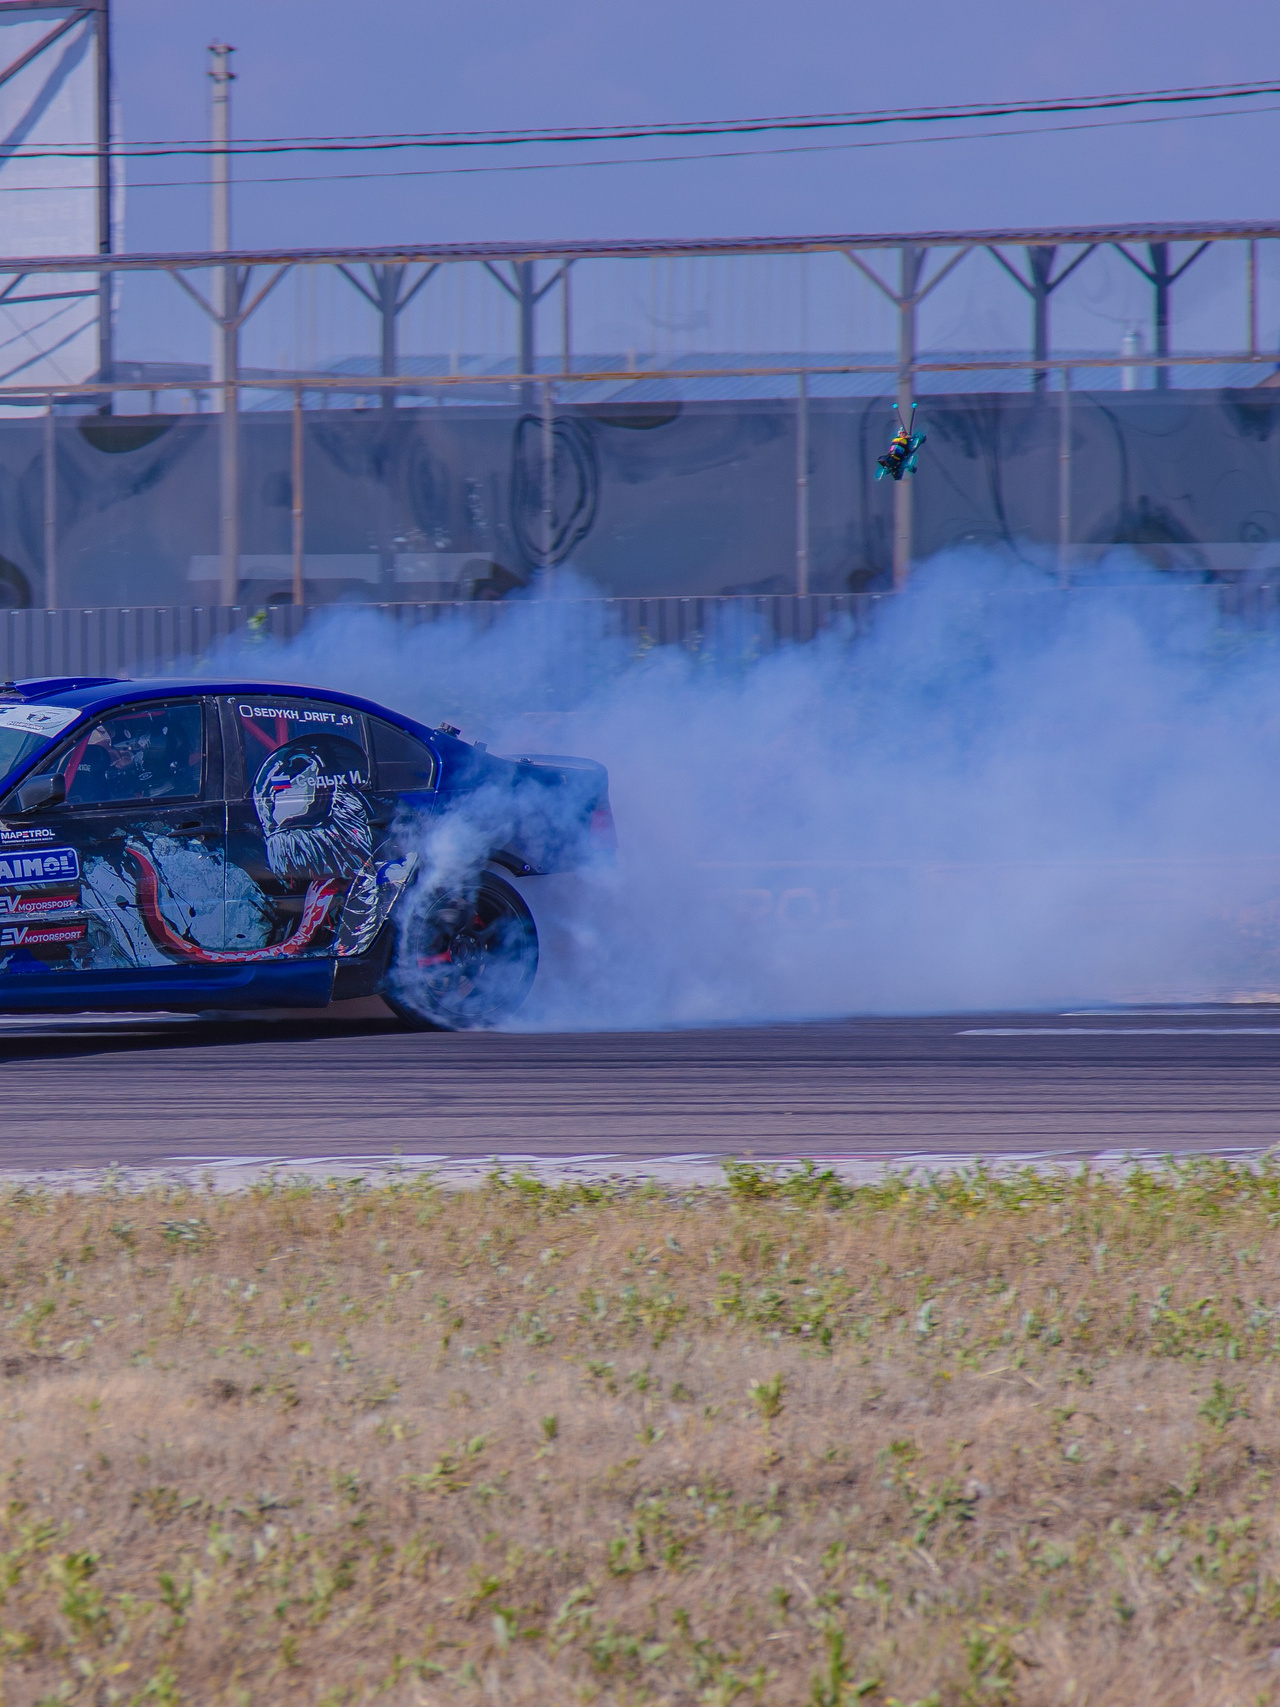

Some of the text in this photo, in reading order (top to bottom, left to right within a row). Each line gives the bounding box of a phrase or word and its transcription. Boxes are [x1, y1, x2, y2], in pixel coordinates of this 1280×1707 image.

[253, 706, 354, 725] SEDYKH_DRIFT_61
[295, 770, 367, 789] Седых И.
[0, 828, 56, 840] MAPETROL
[18, 899, 74, 911] MOTORSPORT
[0, 926, 81, 946] EV MOTORSPORT
